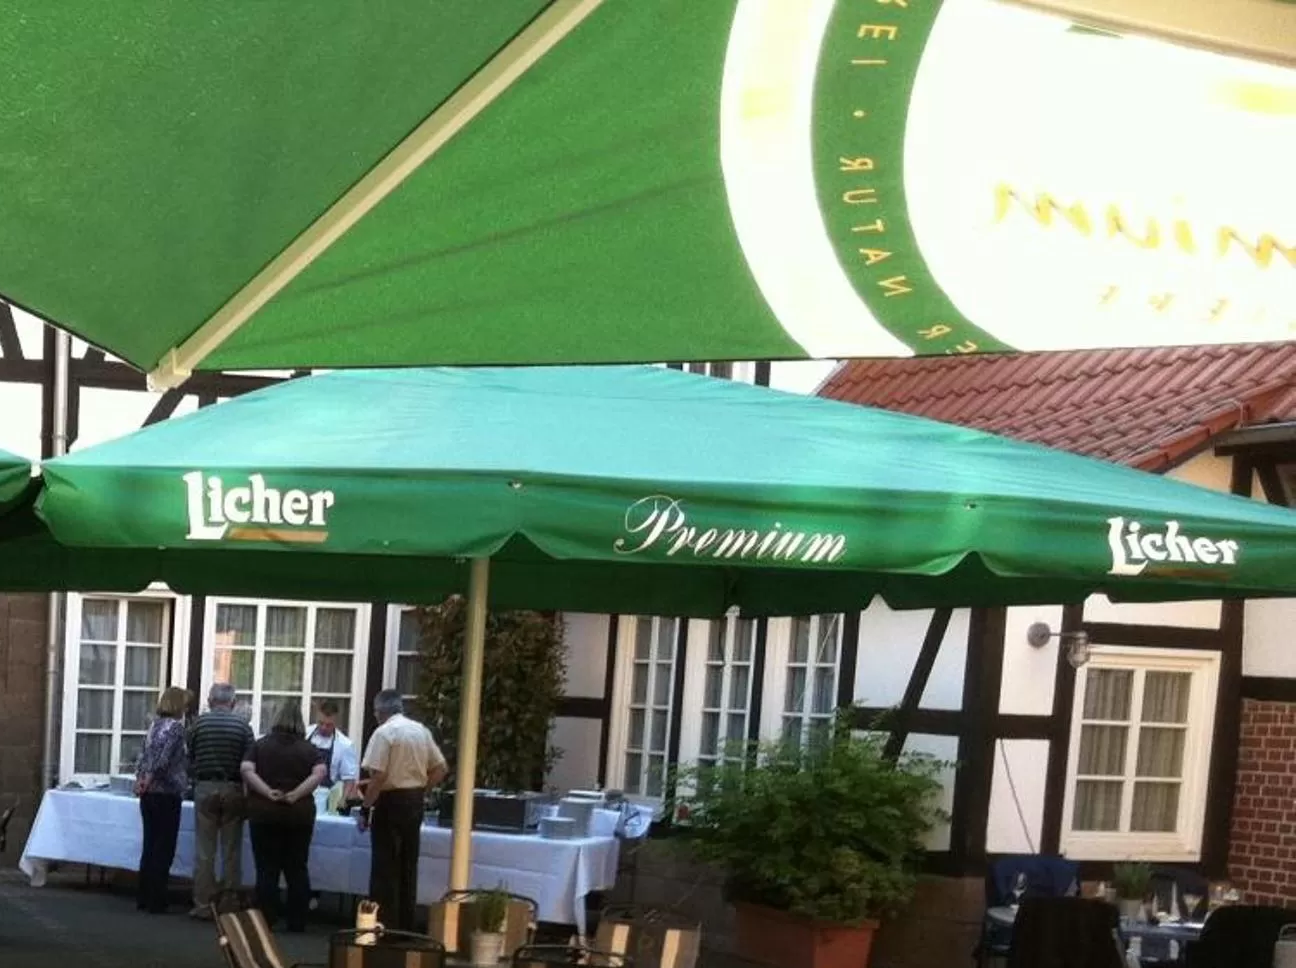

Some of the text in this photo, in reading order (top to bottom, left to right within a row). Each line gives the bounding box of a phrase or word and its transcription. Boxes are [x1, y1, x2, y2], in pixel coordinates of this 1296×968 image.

[181, 470, 336, 542] Licher
[613, 494, 846, 564] Premium
[1107, 515, 1239, 576] Licher
